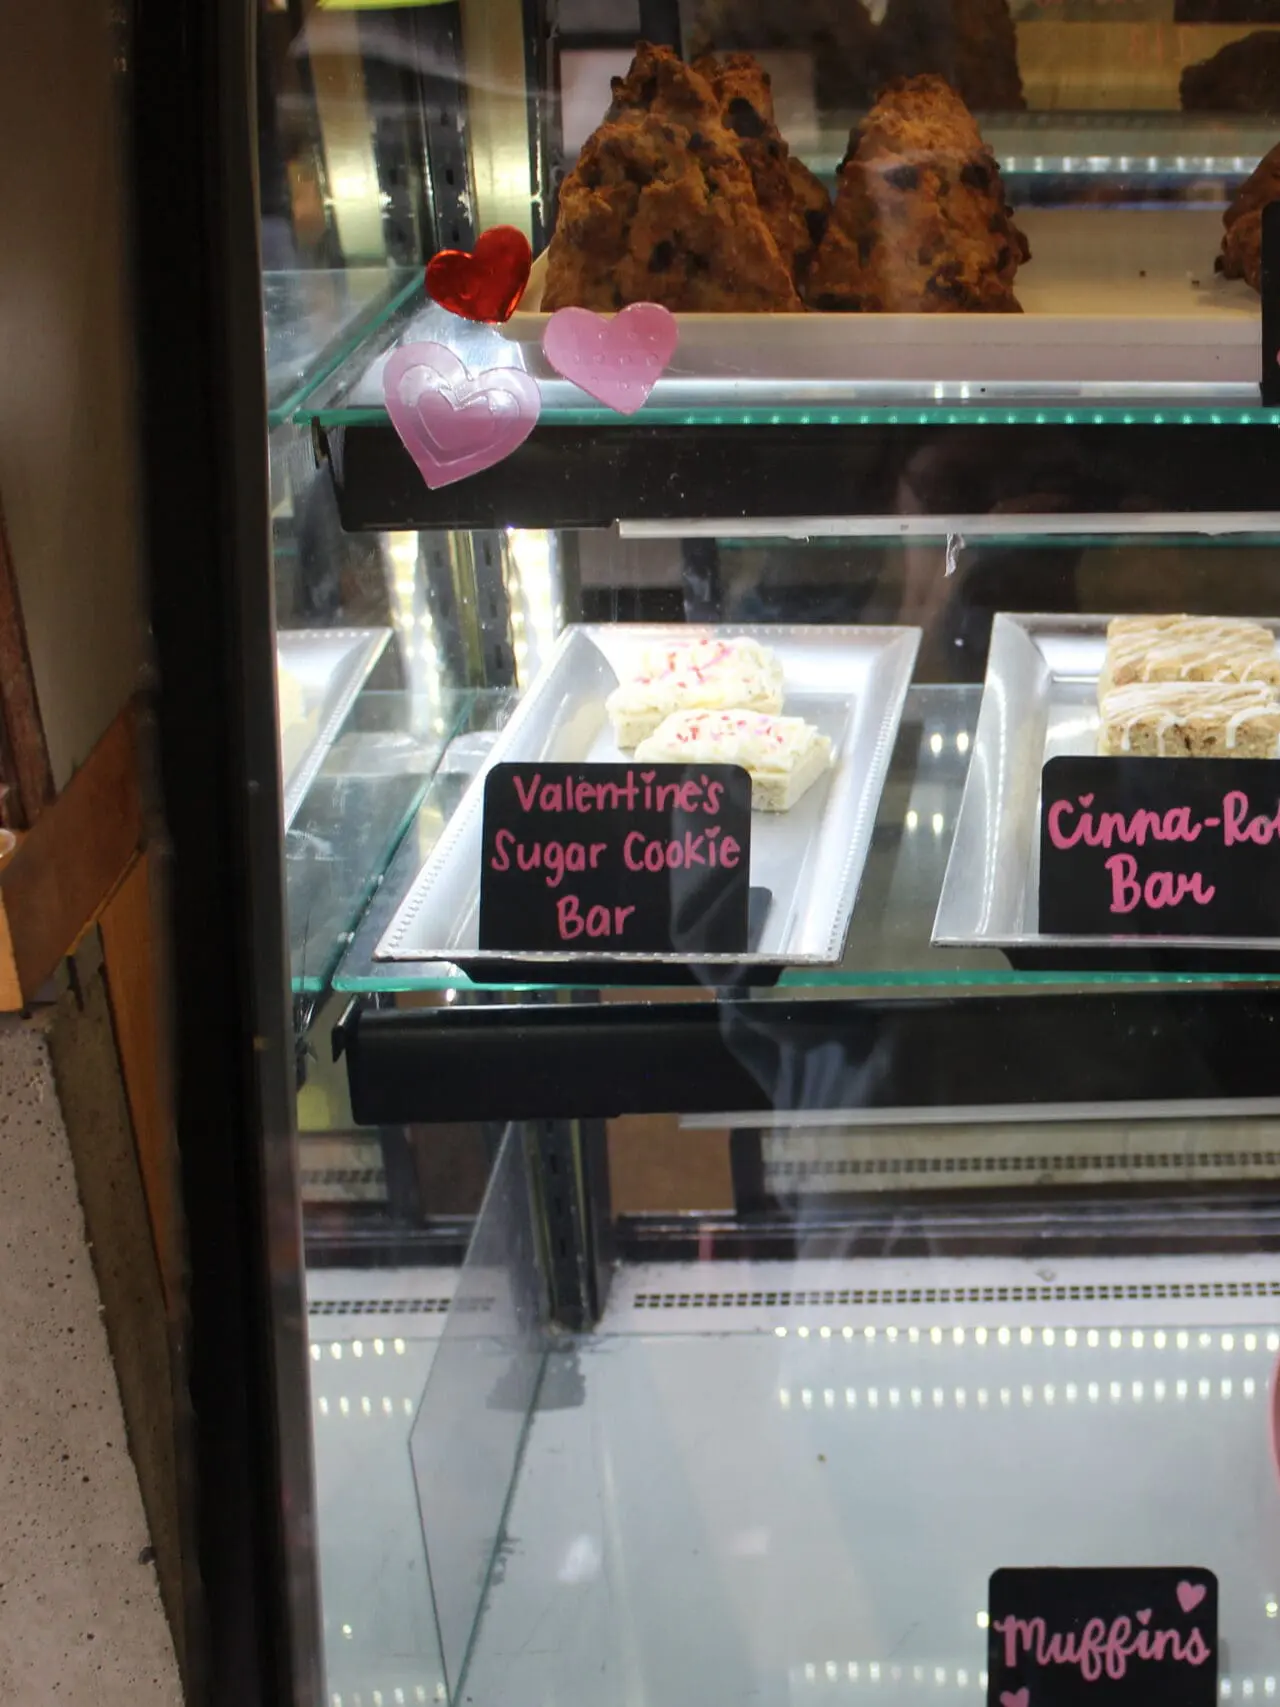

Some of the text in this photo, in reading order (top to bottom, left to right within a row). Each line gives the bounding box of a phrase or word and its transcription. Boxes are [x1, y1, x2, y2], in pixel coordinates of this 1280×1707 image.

[512, 769, 725, 815] Valentine's
[490, 825, 741, 888] Sugar Cookie
[1104, 853, 1217, 914] Bar
[555, 894, 636, 941] Bar
[993, 1610, 1210, 1682] Muffins
